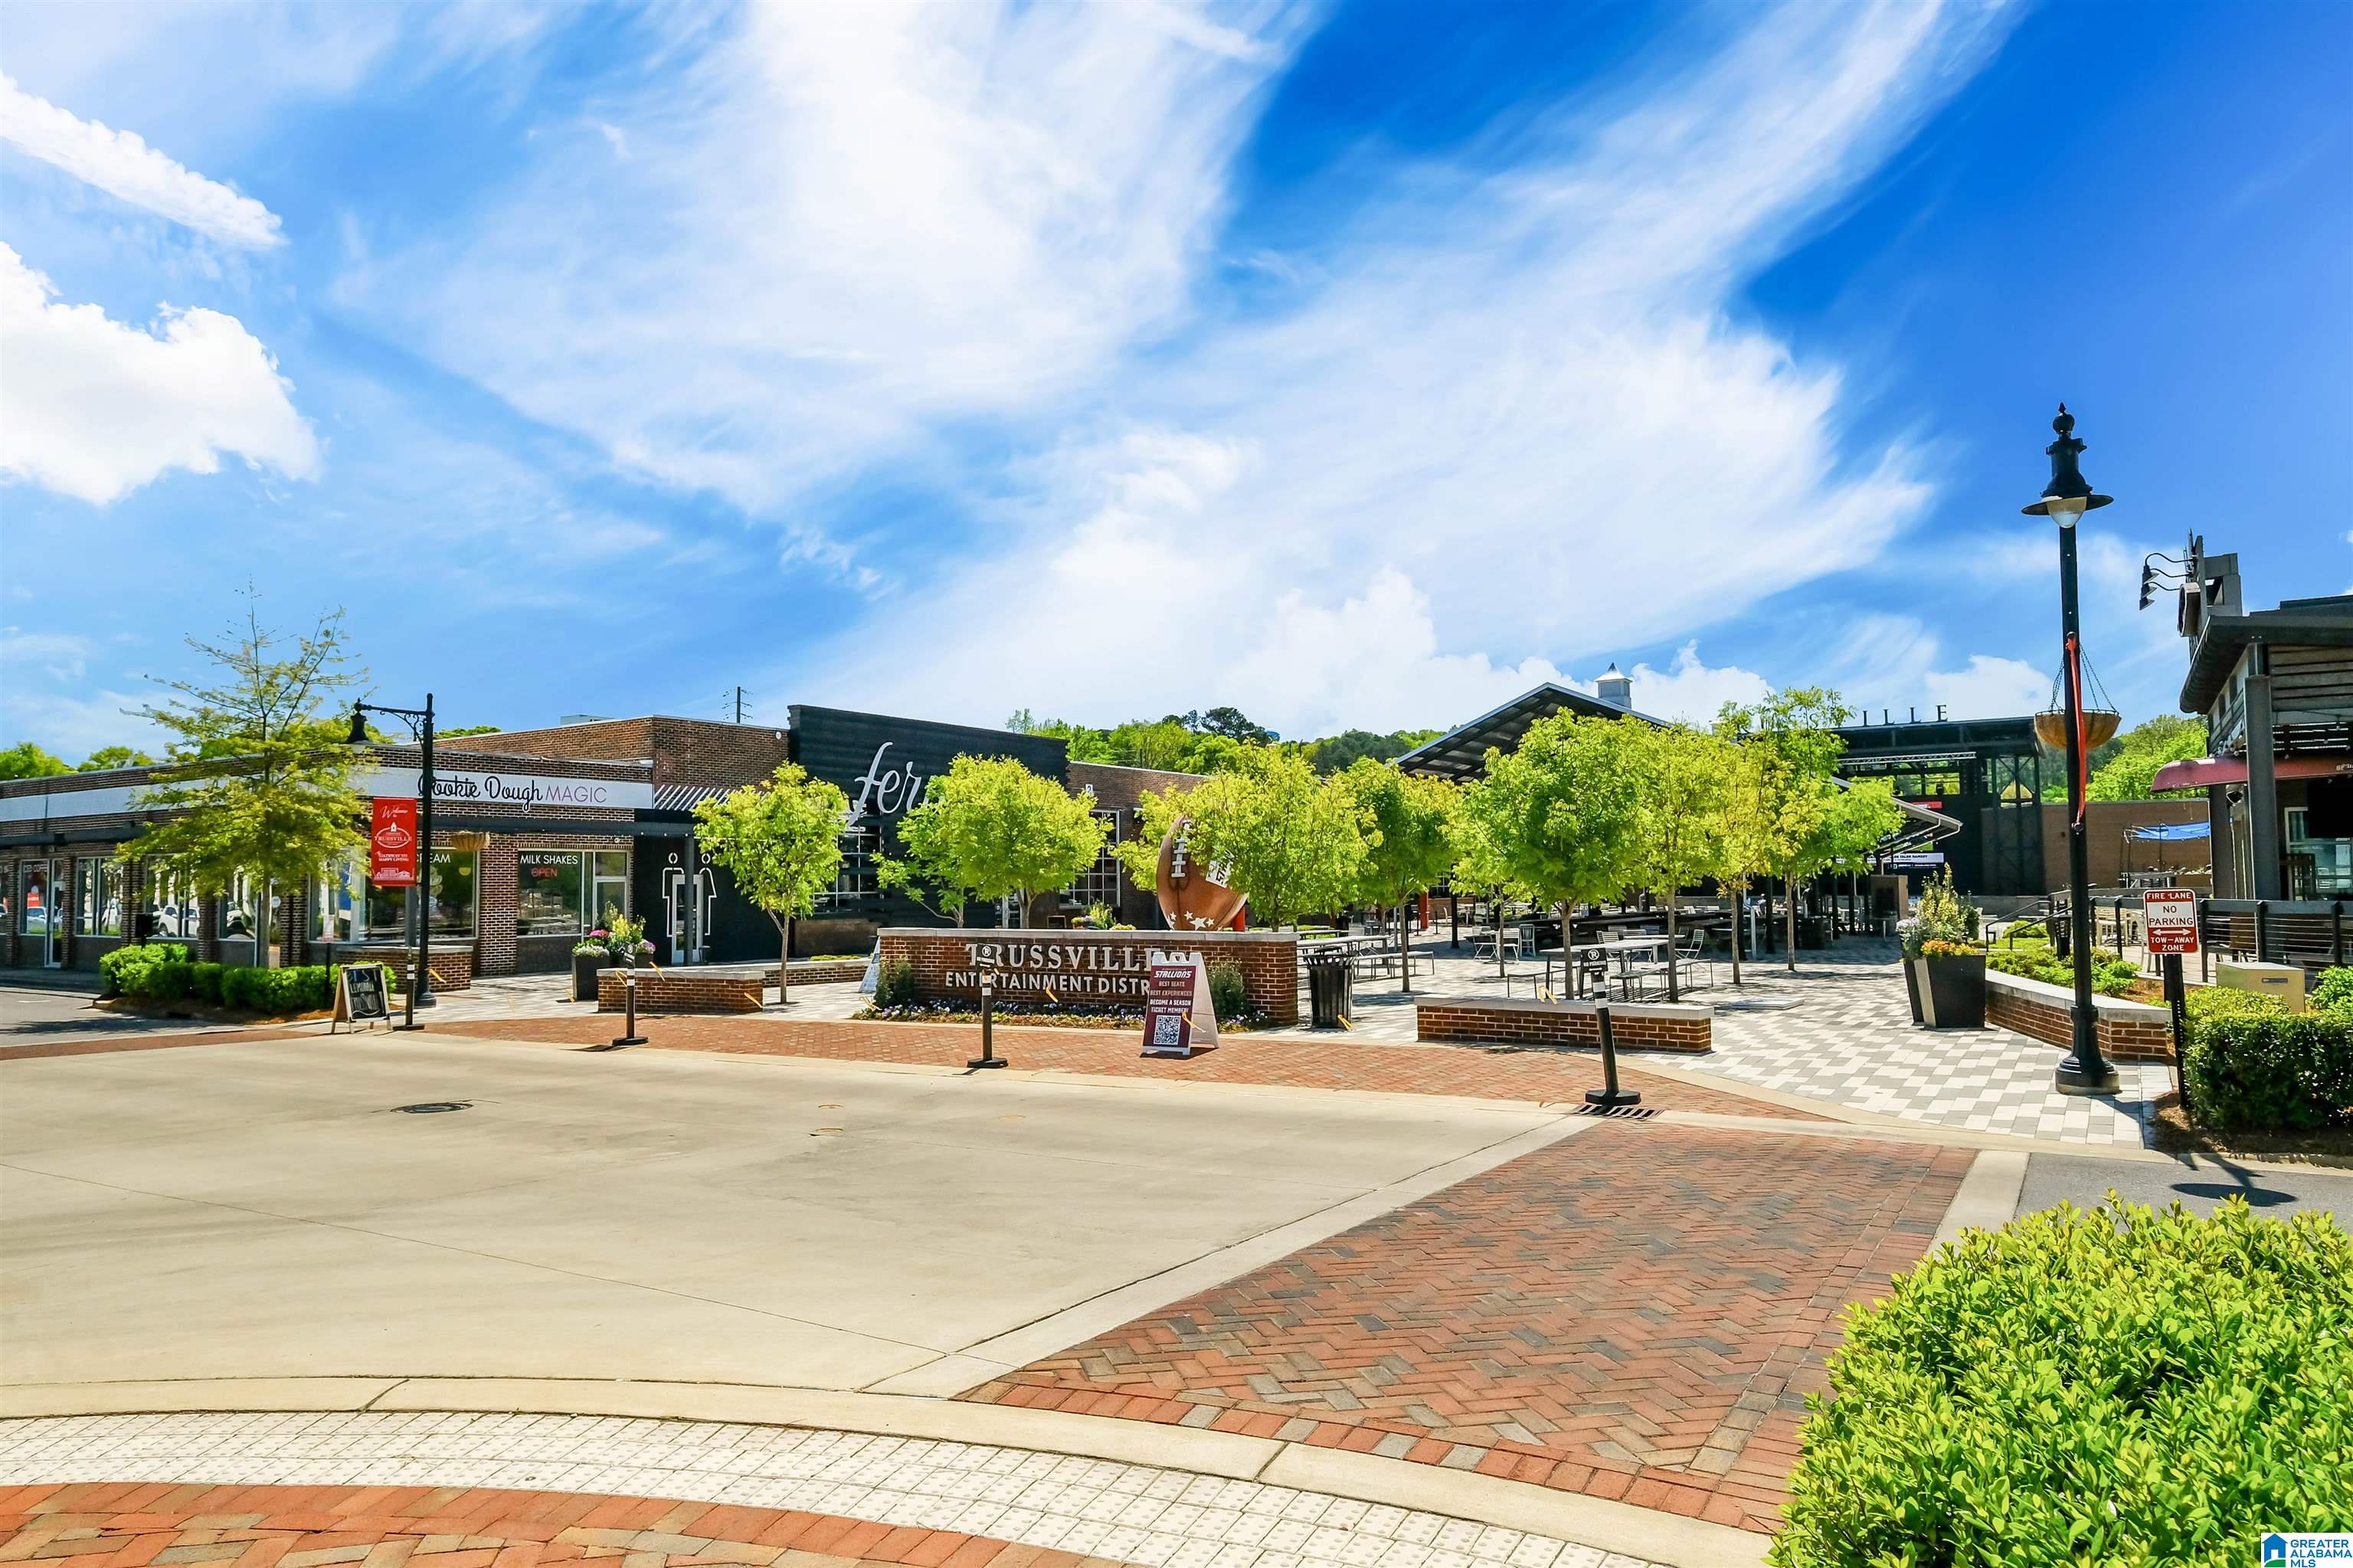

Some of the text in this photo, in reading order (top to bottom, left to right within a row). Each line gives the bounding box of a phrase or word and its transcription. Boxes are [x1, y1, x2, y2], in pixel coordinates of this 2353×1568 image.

[846, 741, 929, 827] fer
[485, 776, 543, 812] Dough
[545, 784, 607, 803] MAGIC
[520, 855, 578, 864] MILK SHAKES
[531, 867, 558, 877] OPEN
[2149, 918, 2194, 926] PARKING
[1098, 977, 1150, 996] DISTR
